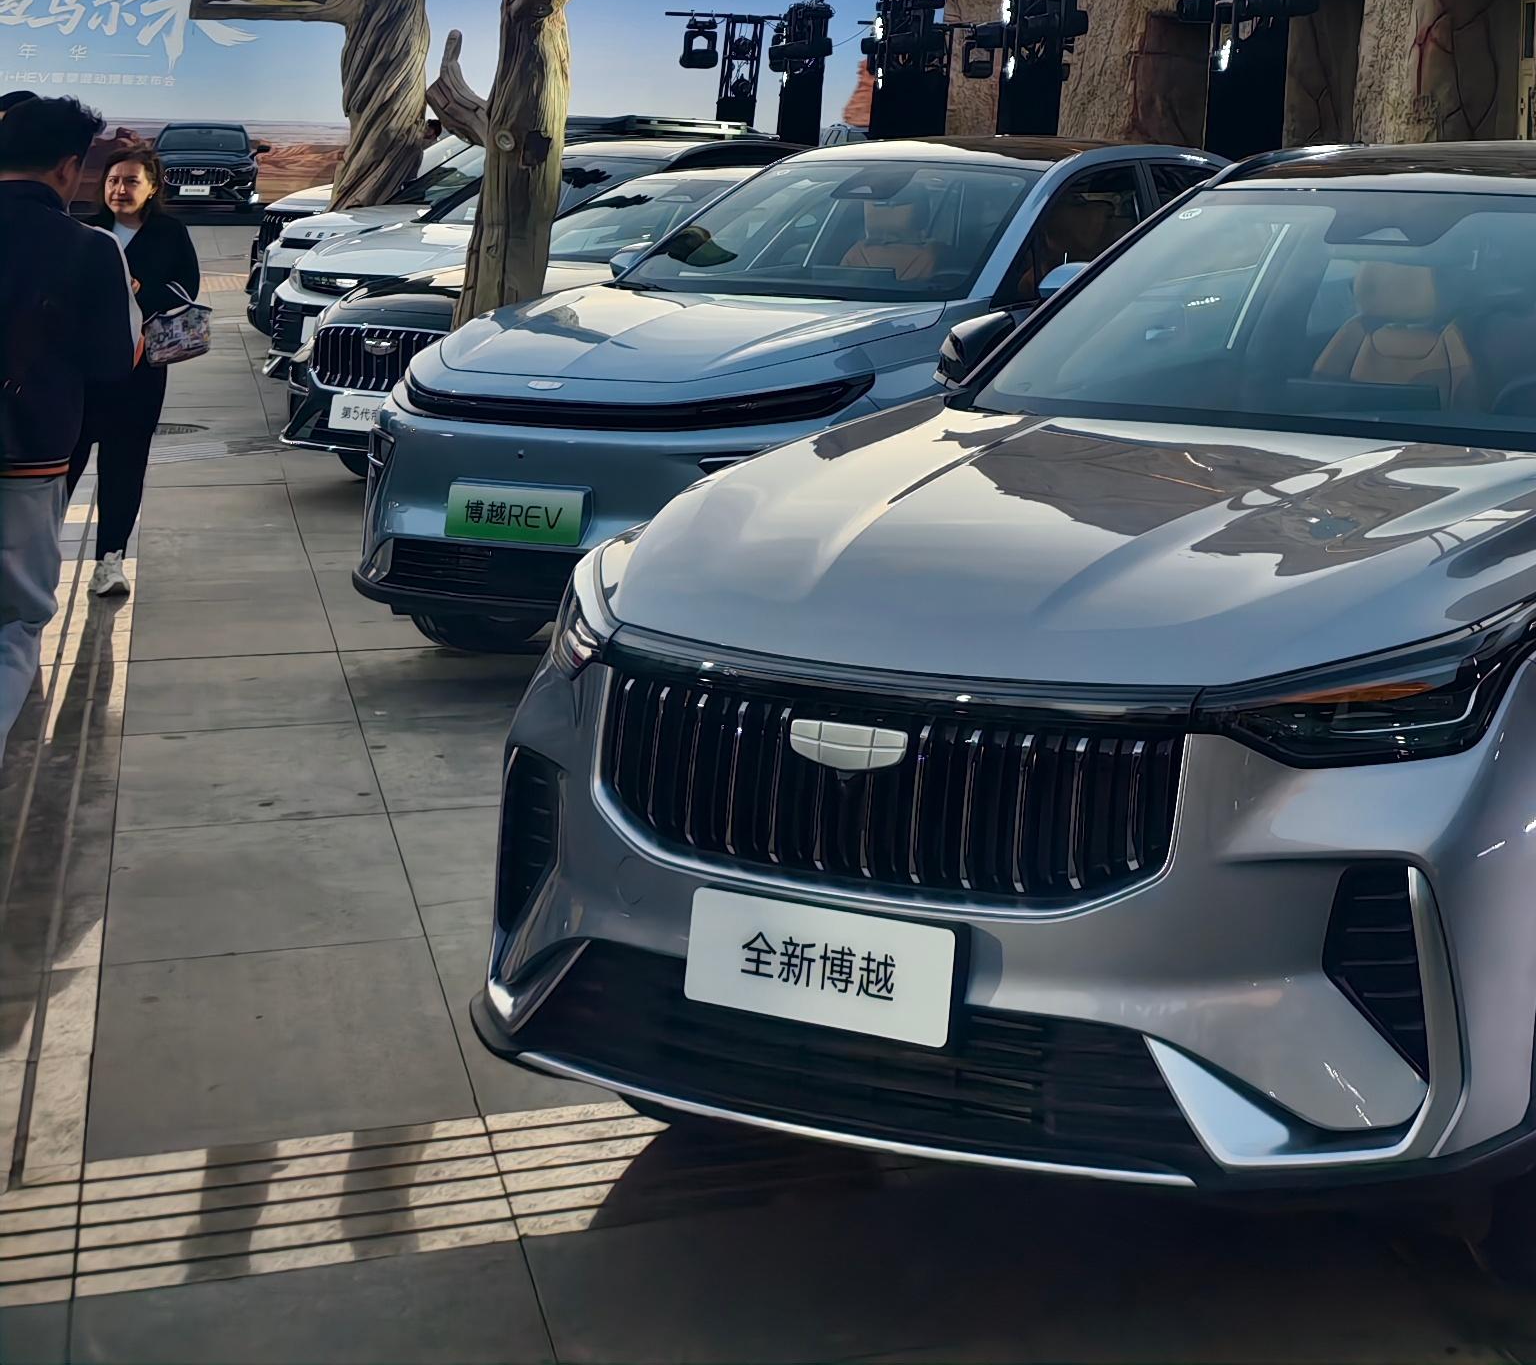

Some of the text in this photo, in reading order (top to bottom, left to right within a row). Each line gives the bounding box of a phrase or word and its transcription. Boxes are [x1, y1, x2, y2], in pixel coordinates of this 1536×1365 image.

[464, 499, 563, 530] 博越REV
[740, 930, 897, 1002] 全新博越
